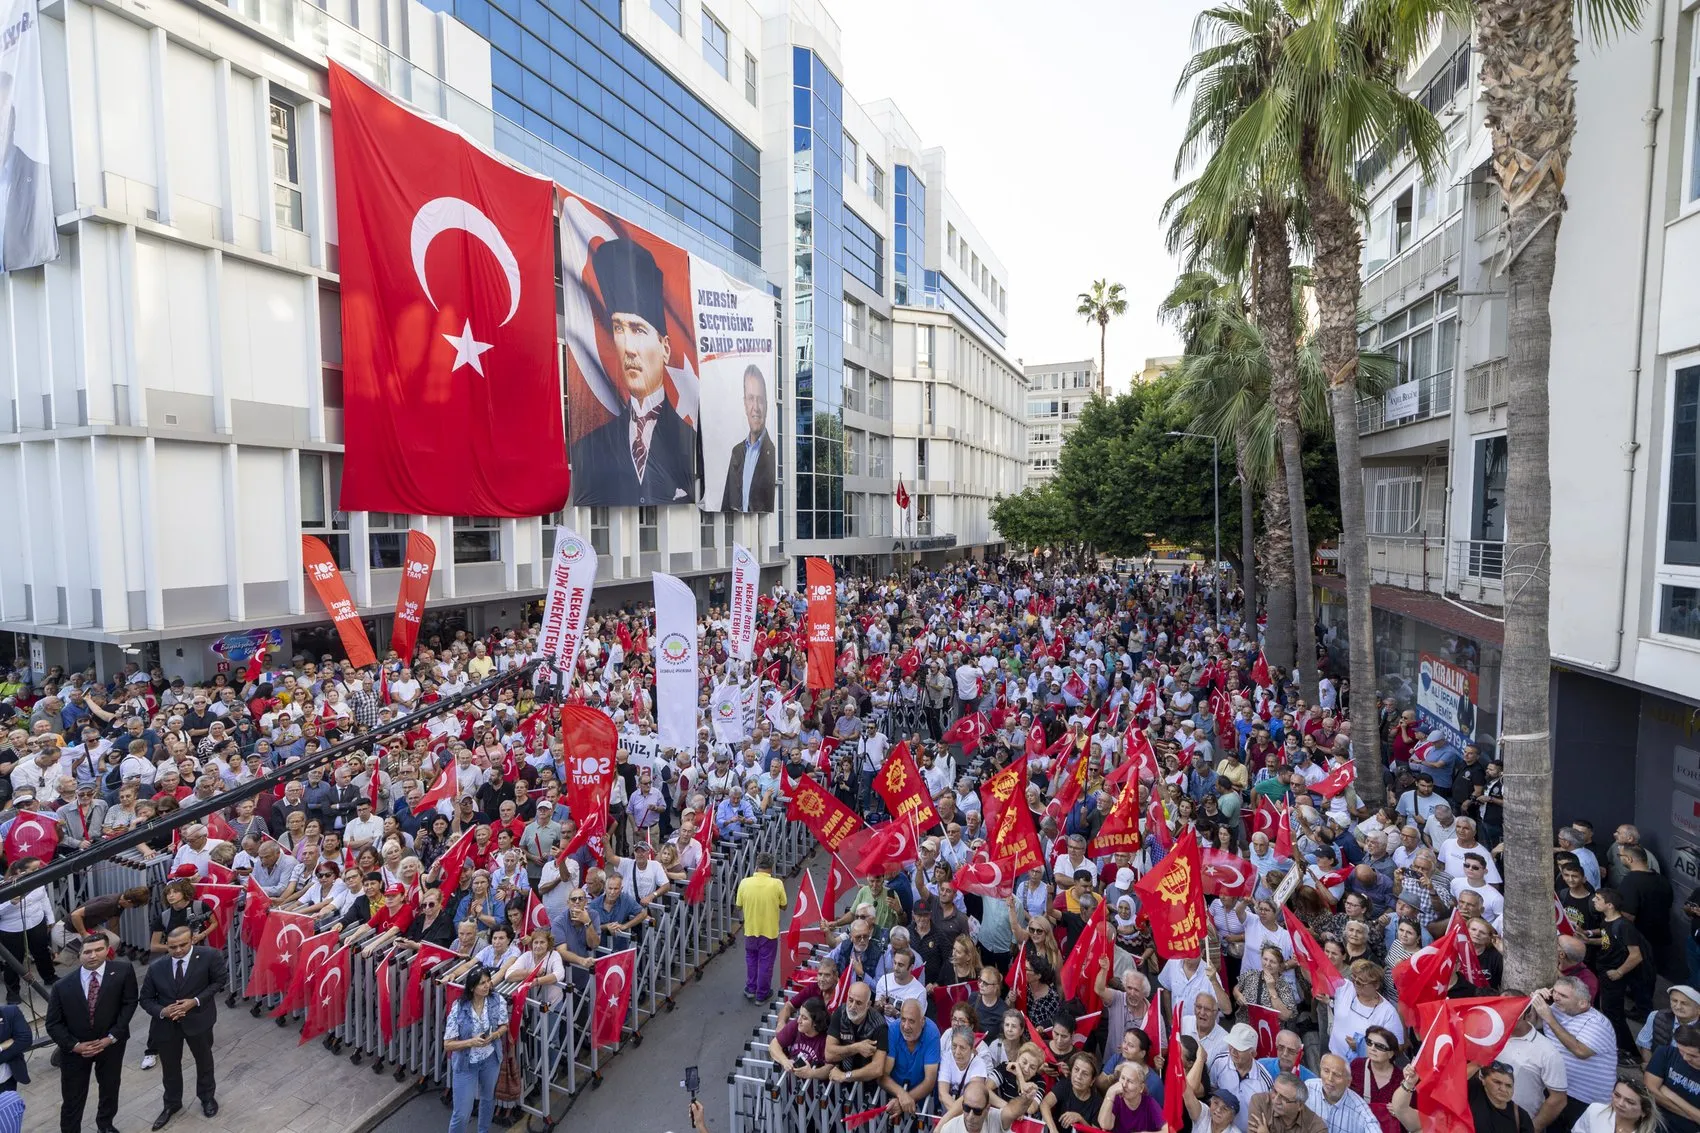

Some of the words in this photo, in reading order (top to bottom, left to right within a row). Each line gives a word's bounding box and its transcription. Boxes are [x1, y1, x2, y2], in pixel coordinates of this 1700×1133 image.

[698, 289, 738, 309] MERSİN
[698, 312, 754, 334] SEÇTİĞİNE
[700, 333, 733, 353] SAHİP
[736, 338, 773, 356] ÇIKIYOR
